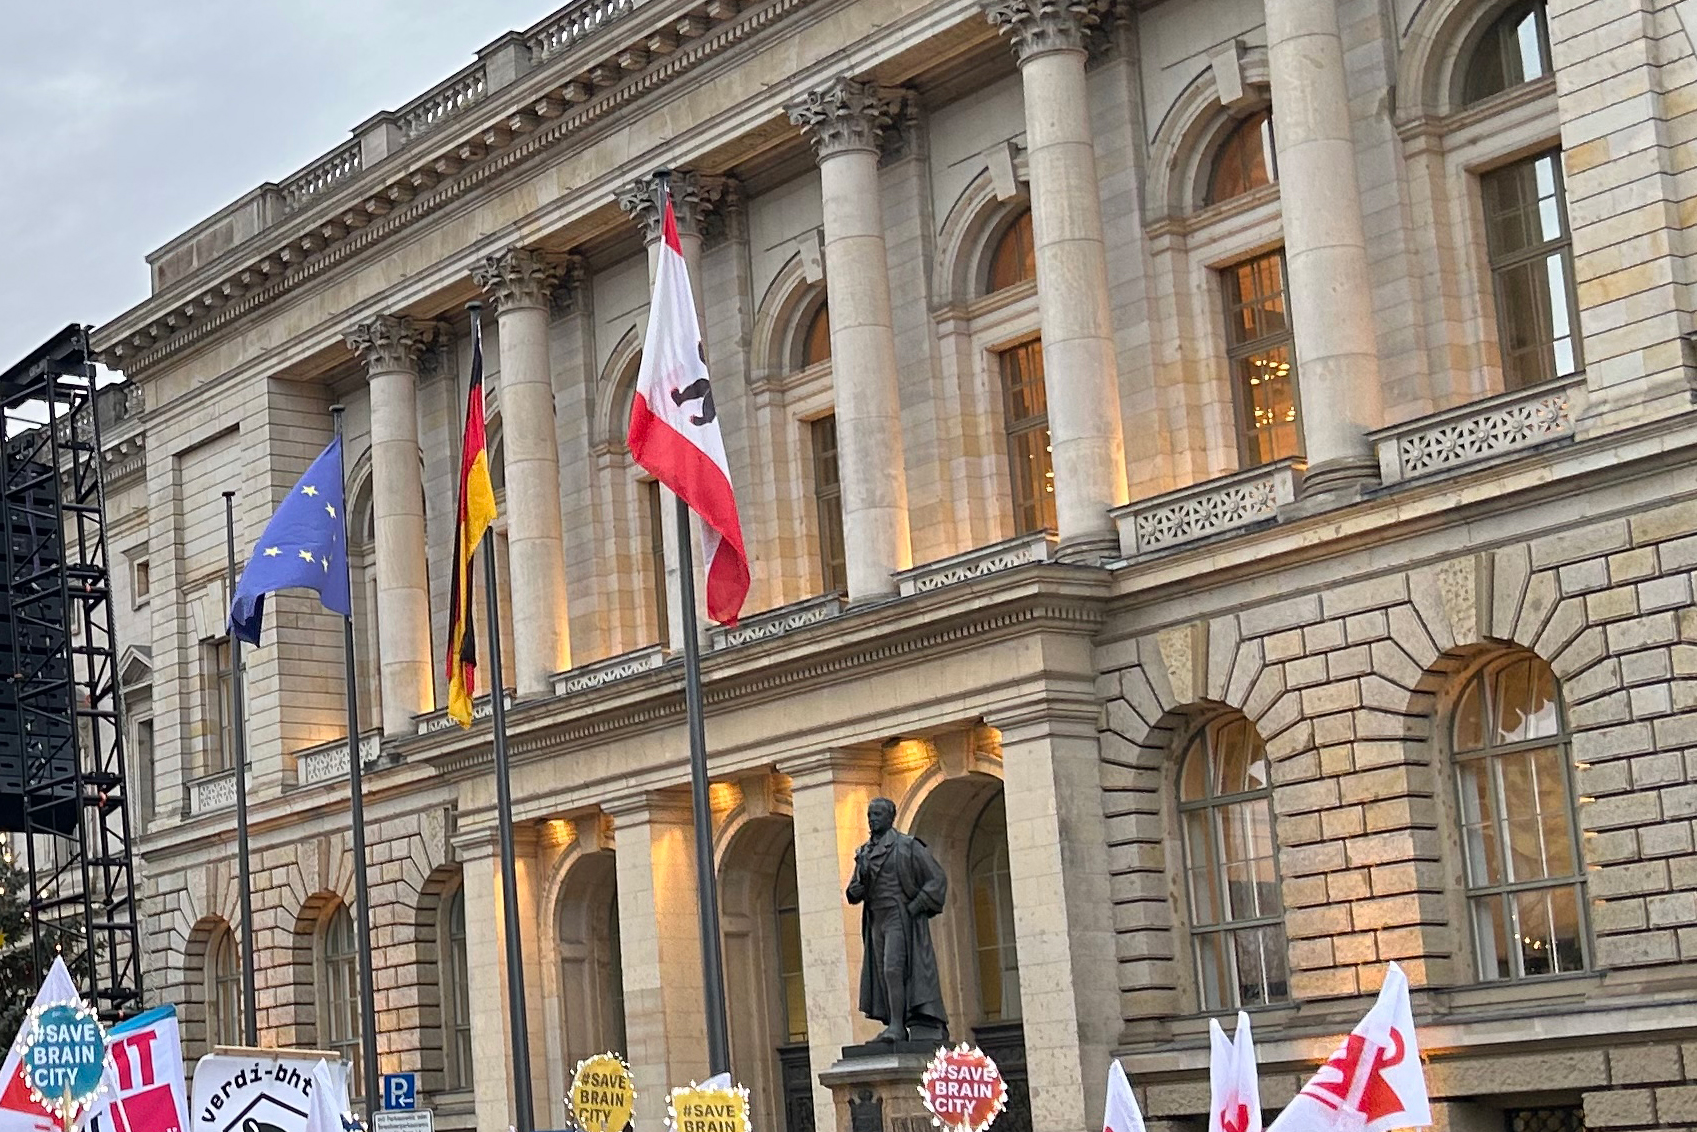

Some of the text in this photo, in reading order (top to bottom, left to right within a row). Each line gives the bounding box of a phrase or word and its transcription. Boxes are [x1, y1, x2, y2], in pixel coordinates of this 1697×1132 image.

[34, 1023, 96, 1043] #SAVE
[34, 1045, 95, 1065] BRAIN
[34, 1066, 79, 1087] CITY
[581, 1072, 627, 1090] #SAVE
[940, 1065, 995, 1083] #SAVE
[391, 1077, 408, 1106] P
[934, 1080, 993, 1099] BRAIN
[579, 1090, 625, 1108] BRAIN
[934, 1099, 977, 1114] CITY
[579, 1107, 612, 1124] CITY
[683, 1103, 736, 1119] #SAVE
